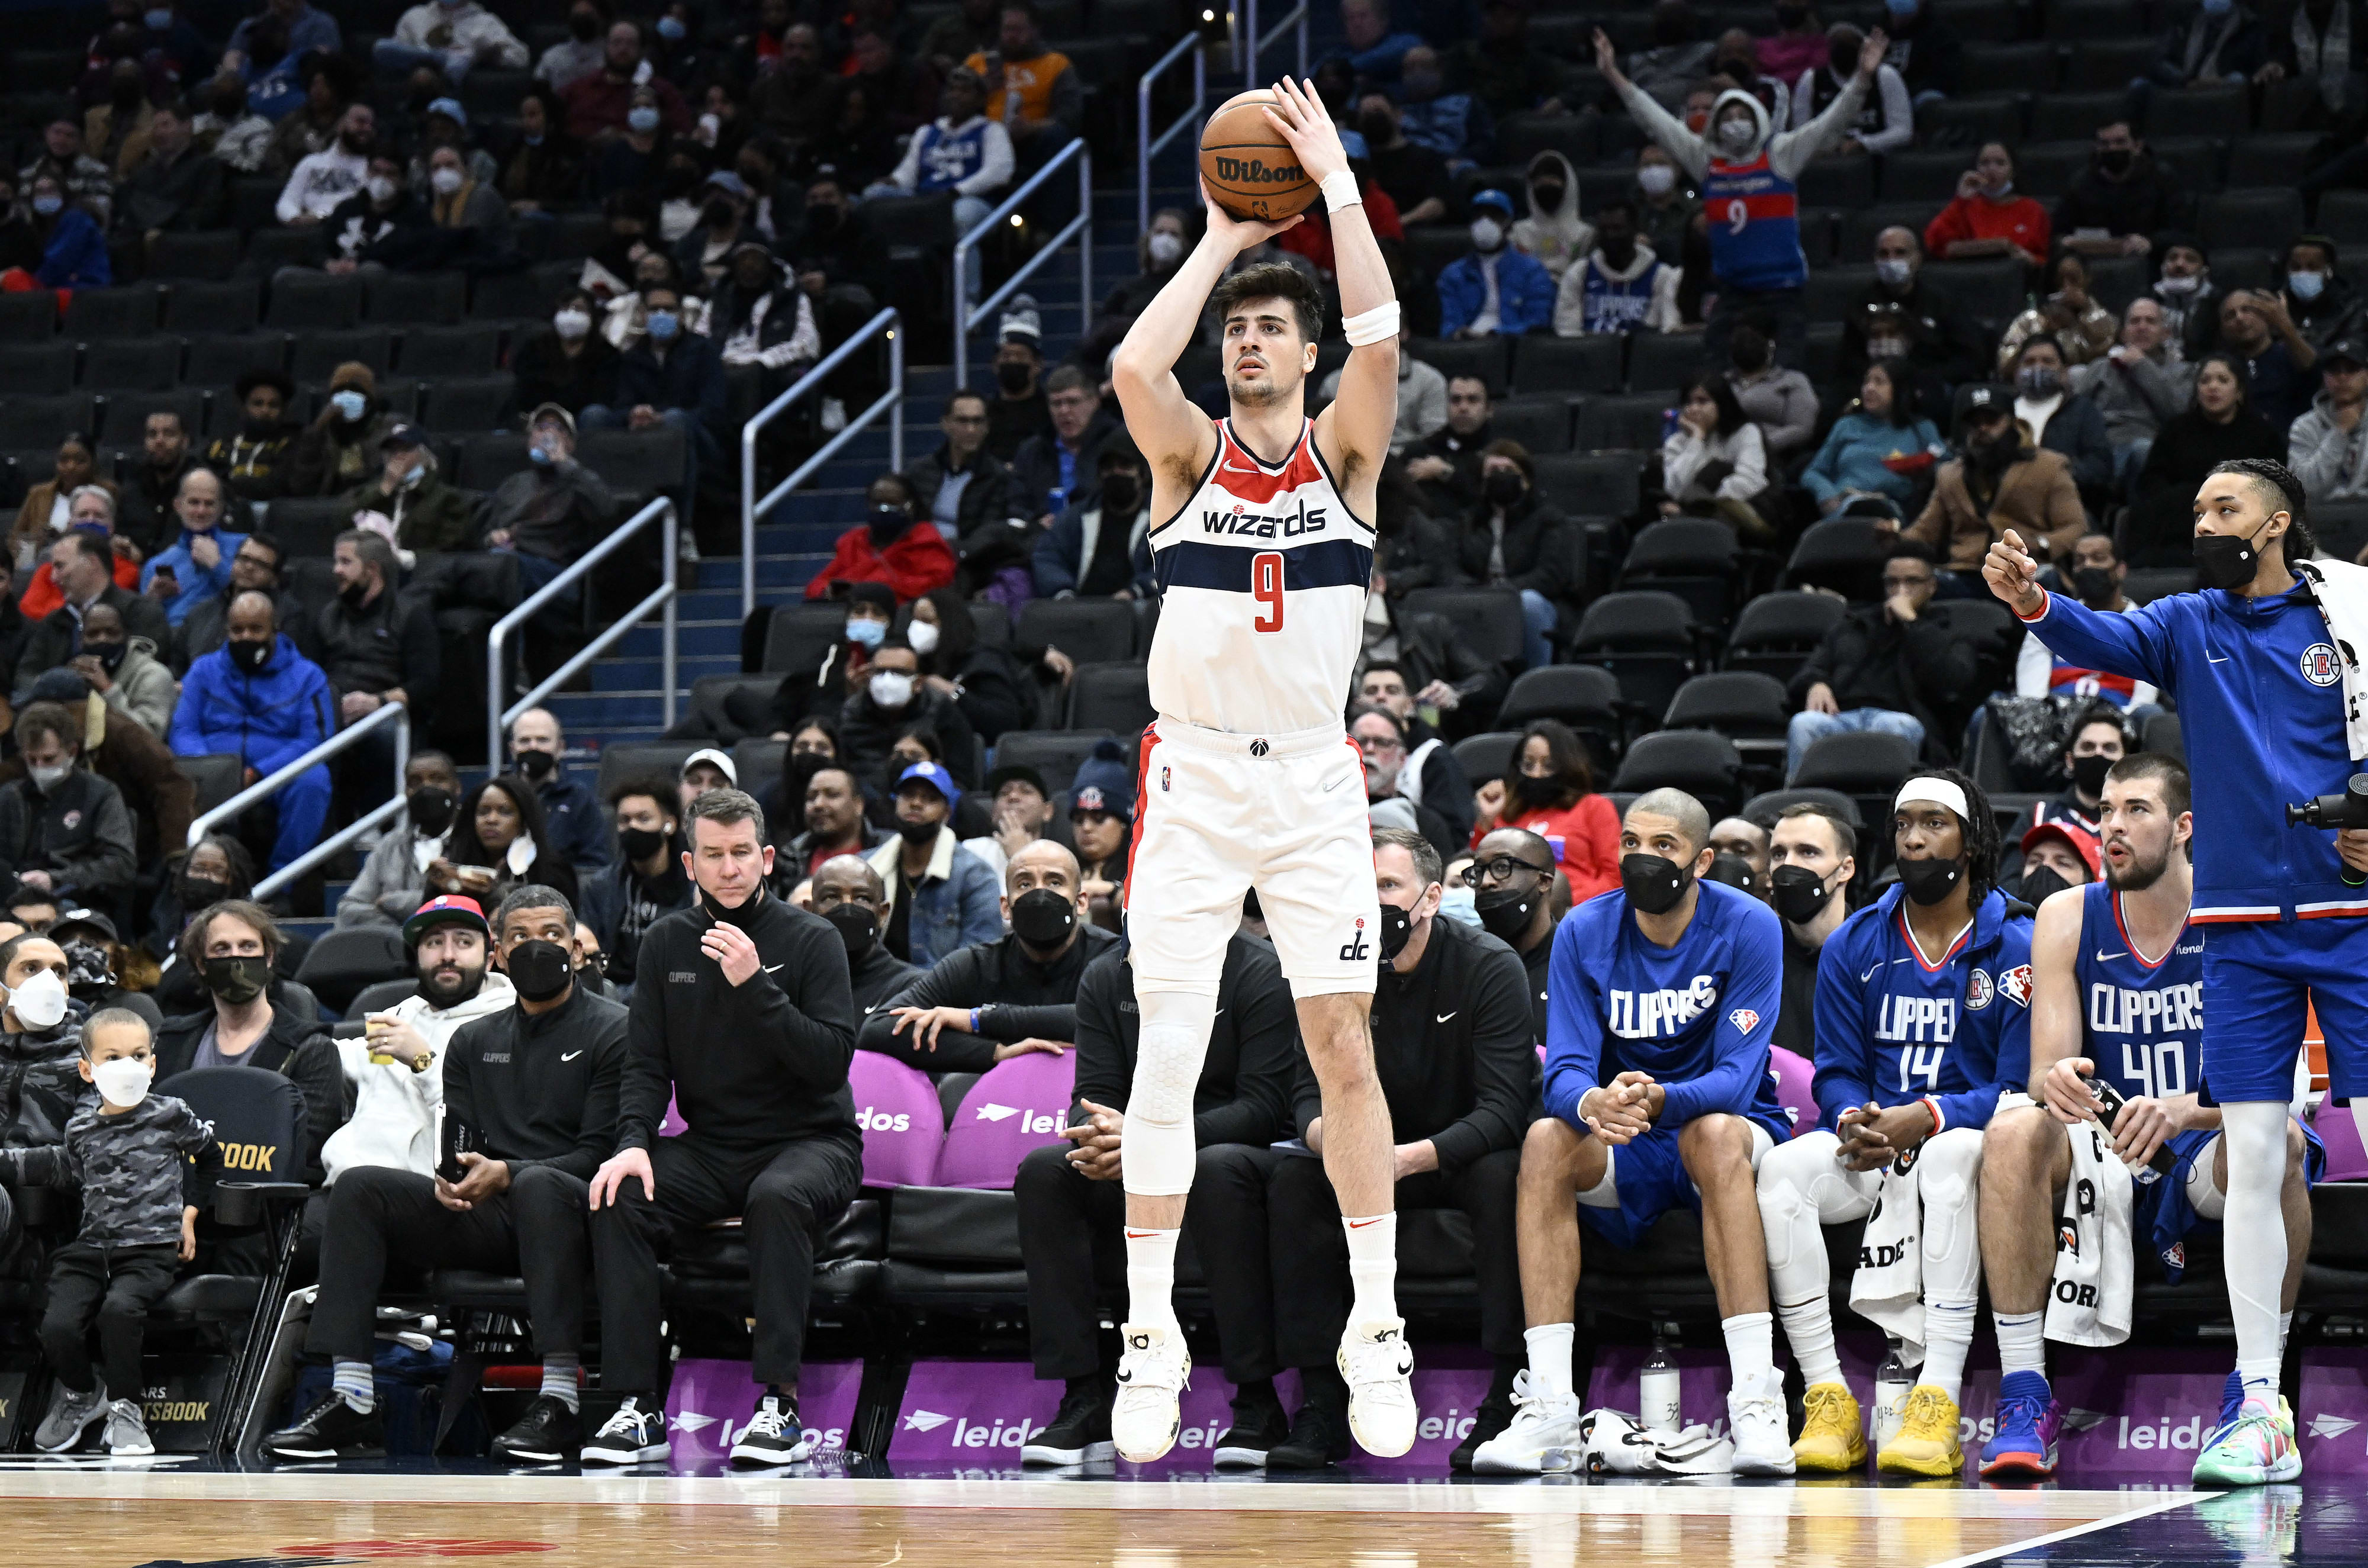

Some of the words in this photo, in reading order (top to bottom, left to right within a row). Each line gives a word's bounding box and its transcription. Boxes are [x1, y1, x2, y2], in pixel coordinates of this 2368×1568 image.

[1216, 156, 1304, 183] Wilson
[1727, 199, 1747, 236] 9
[1203, 498, 1327, 539] wizards
[1253, 553, 1284, 633] 9
[1339, 929, 1369, 961] dc
[1874, 993, 1957, 1043] LIPPE
[2090, 980, 2203, 1034] CLIPPERS
[1899, 1042, 1945, 1093] 14
[2122, 1041, 2186, 1099] 40
[1021, 1109, 1069, 1134] lei
